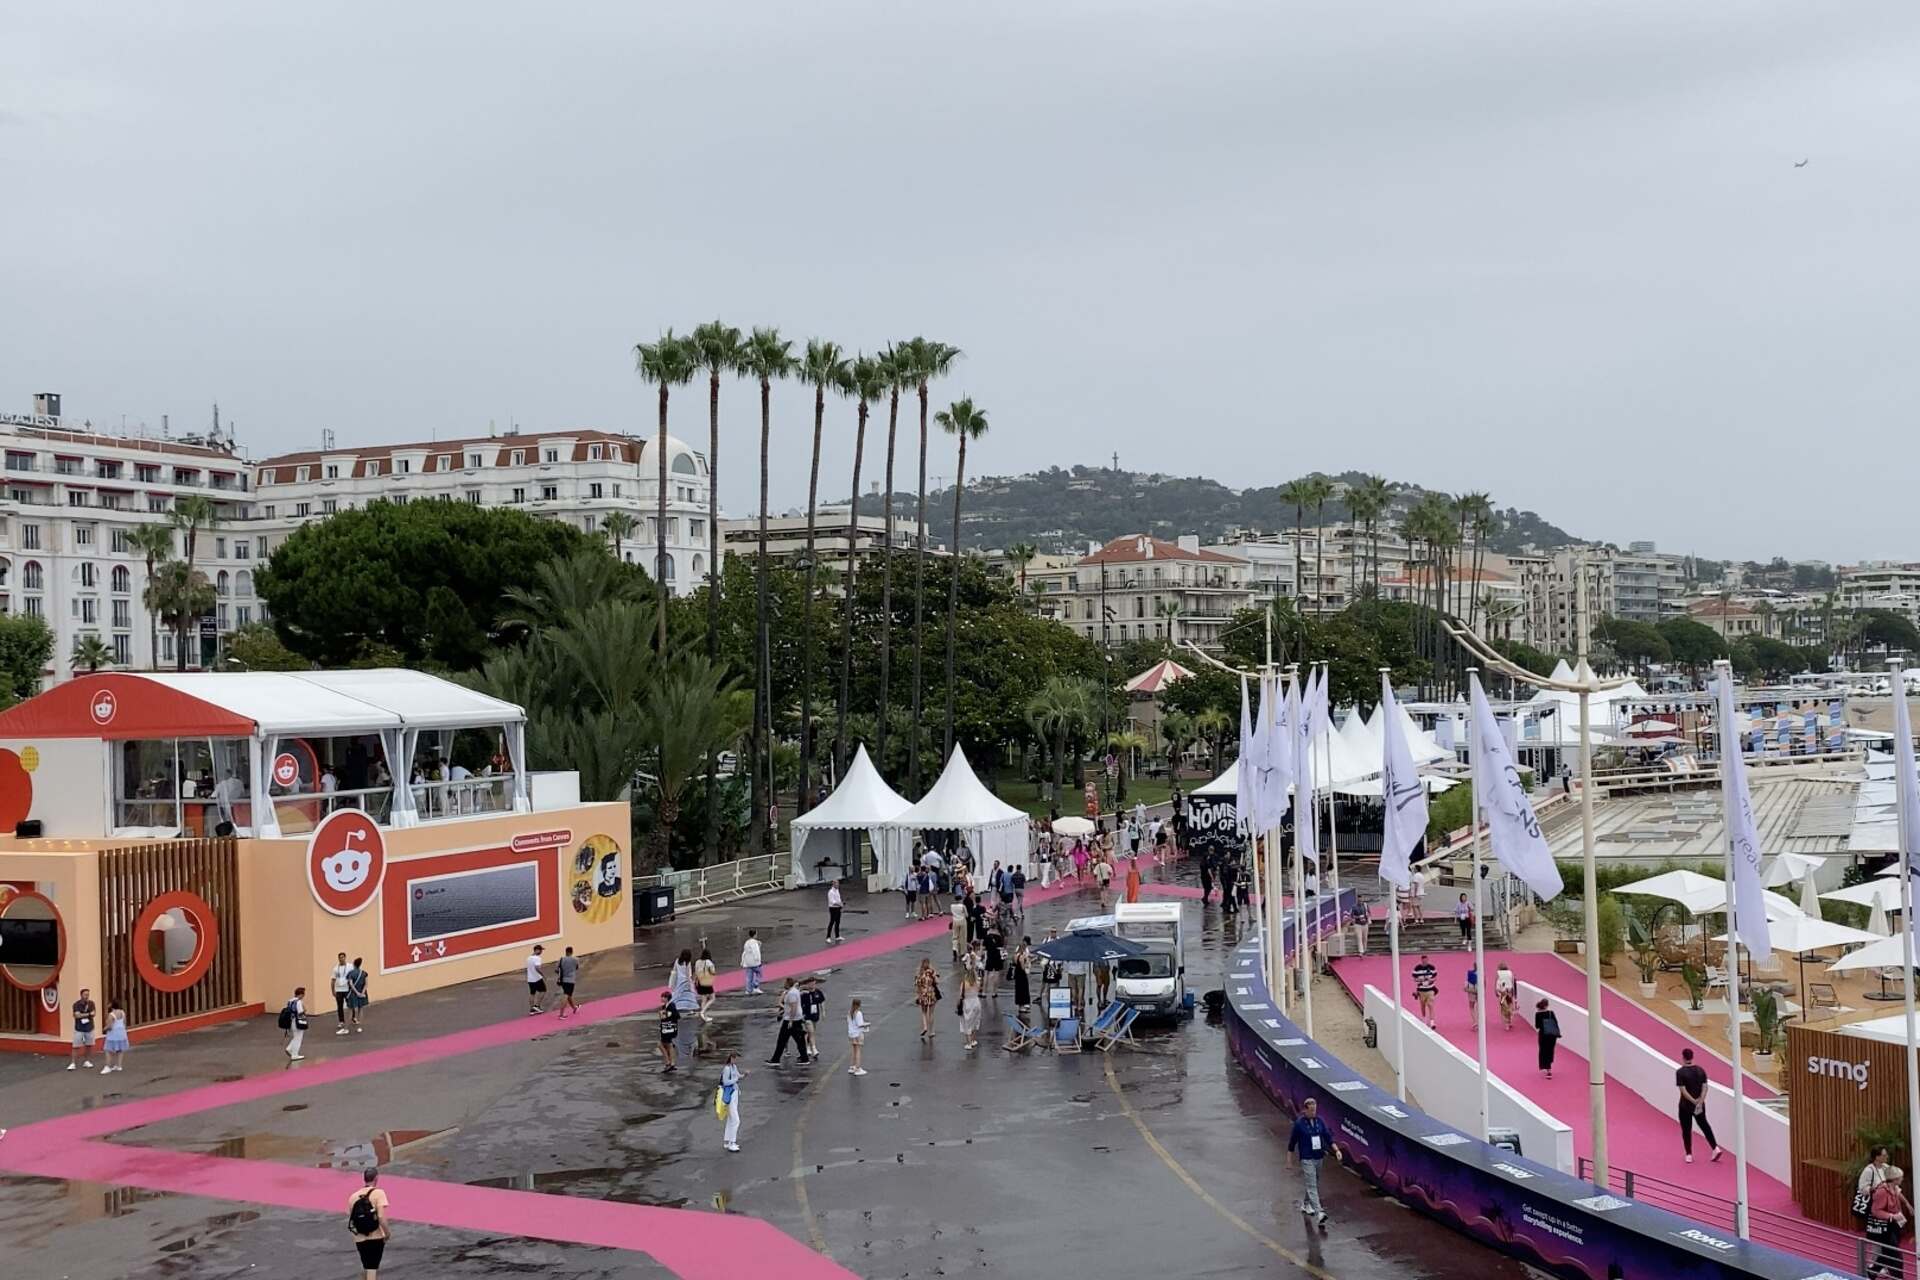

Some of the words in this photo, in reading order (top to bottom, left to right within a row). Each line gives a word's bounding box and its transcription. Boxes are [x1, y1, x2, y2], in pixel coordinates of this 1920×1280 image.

[1188, 803, 1237, 831] HOME
[1218, 818, 1235, 831] OF
[1807, 1056, 1871, 1090] srmg
